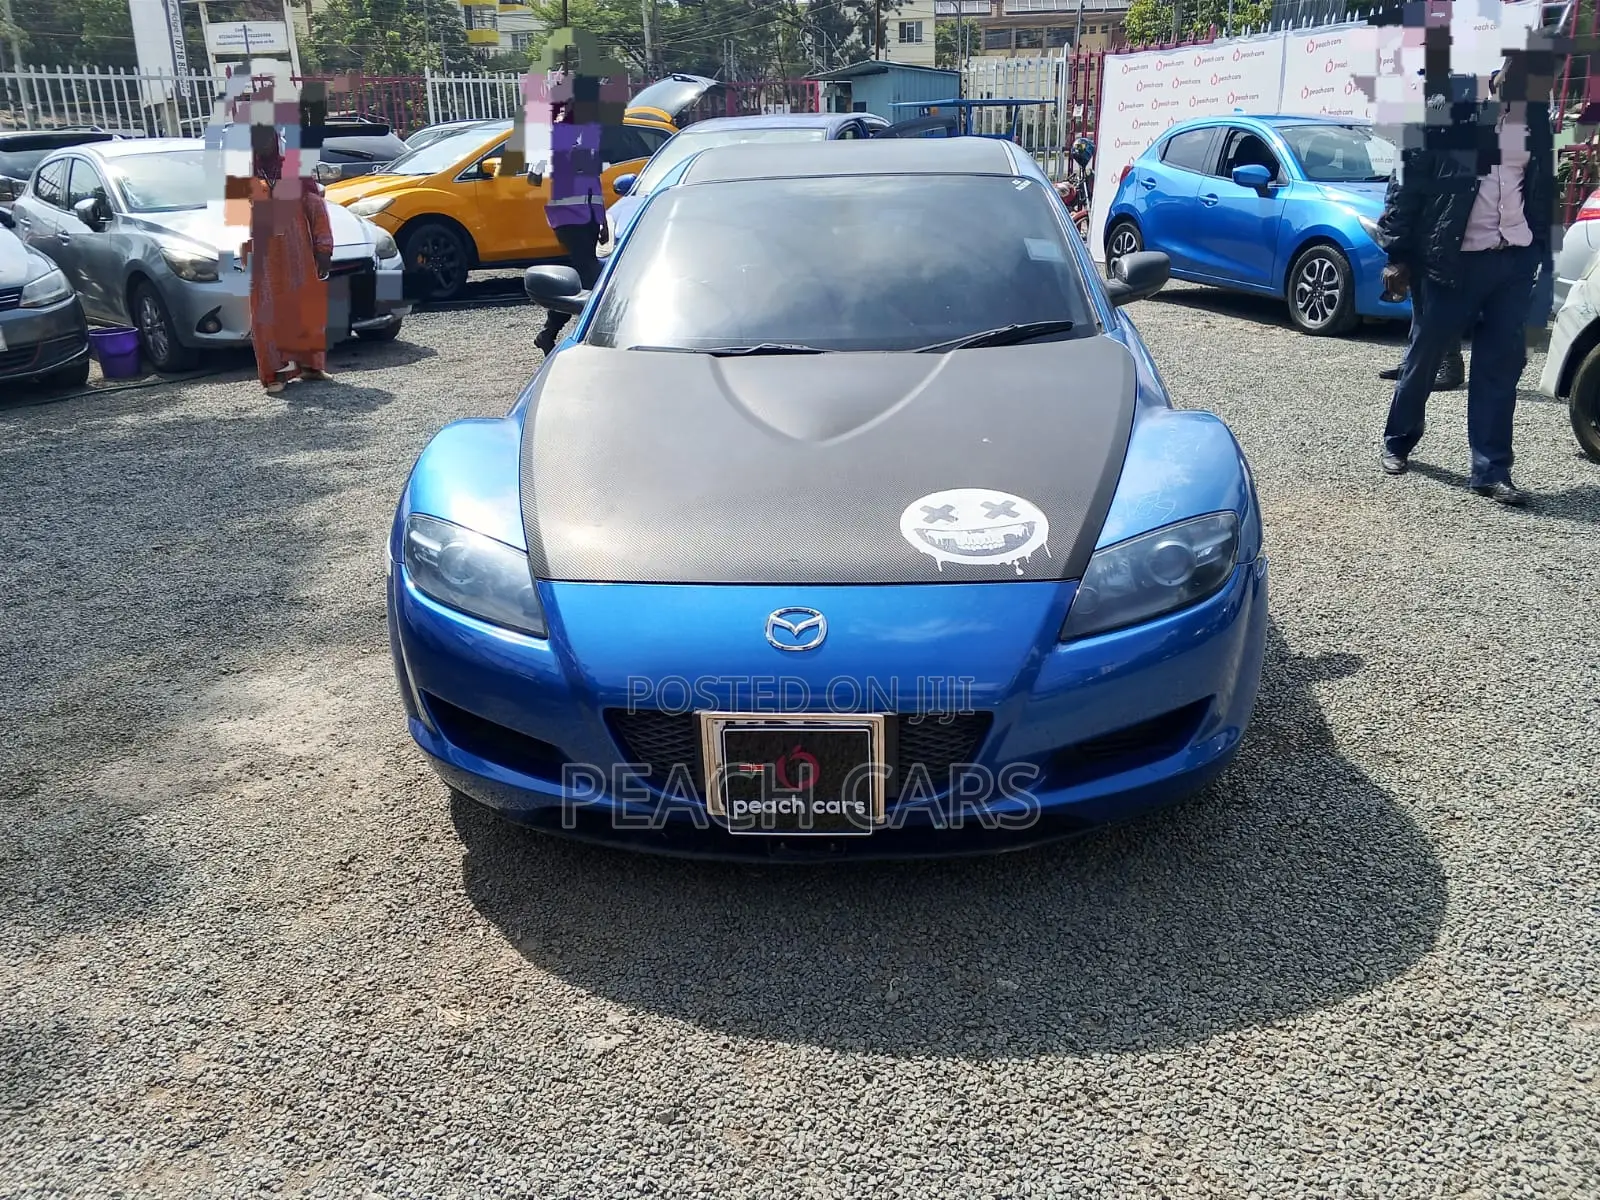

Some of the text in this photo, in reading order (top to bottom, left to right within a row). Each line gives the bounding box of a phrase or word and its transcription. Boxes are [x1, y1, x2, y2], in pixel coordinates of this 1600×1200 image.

[1315, 39, 1330, 50] peach
[1201, 56, 1214, 64] peach
[1240, 50, 1254, 60] peach
[1218, 74, 1231, 83] peach
[1309, 86, 1324, 96] peach
[1234, 93, 1248, 103] peach
[733, 795, 866, 819] peach cars
